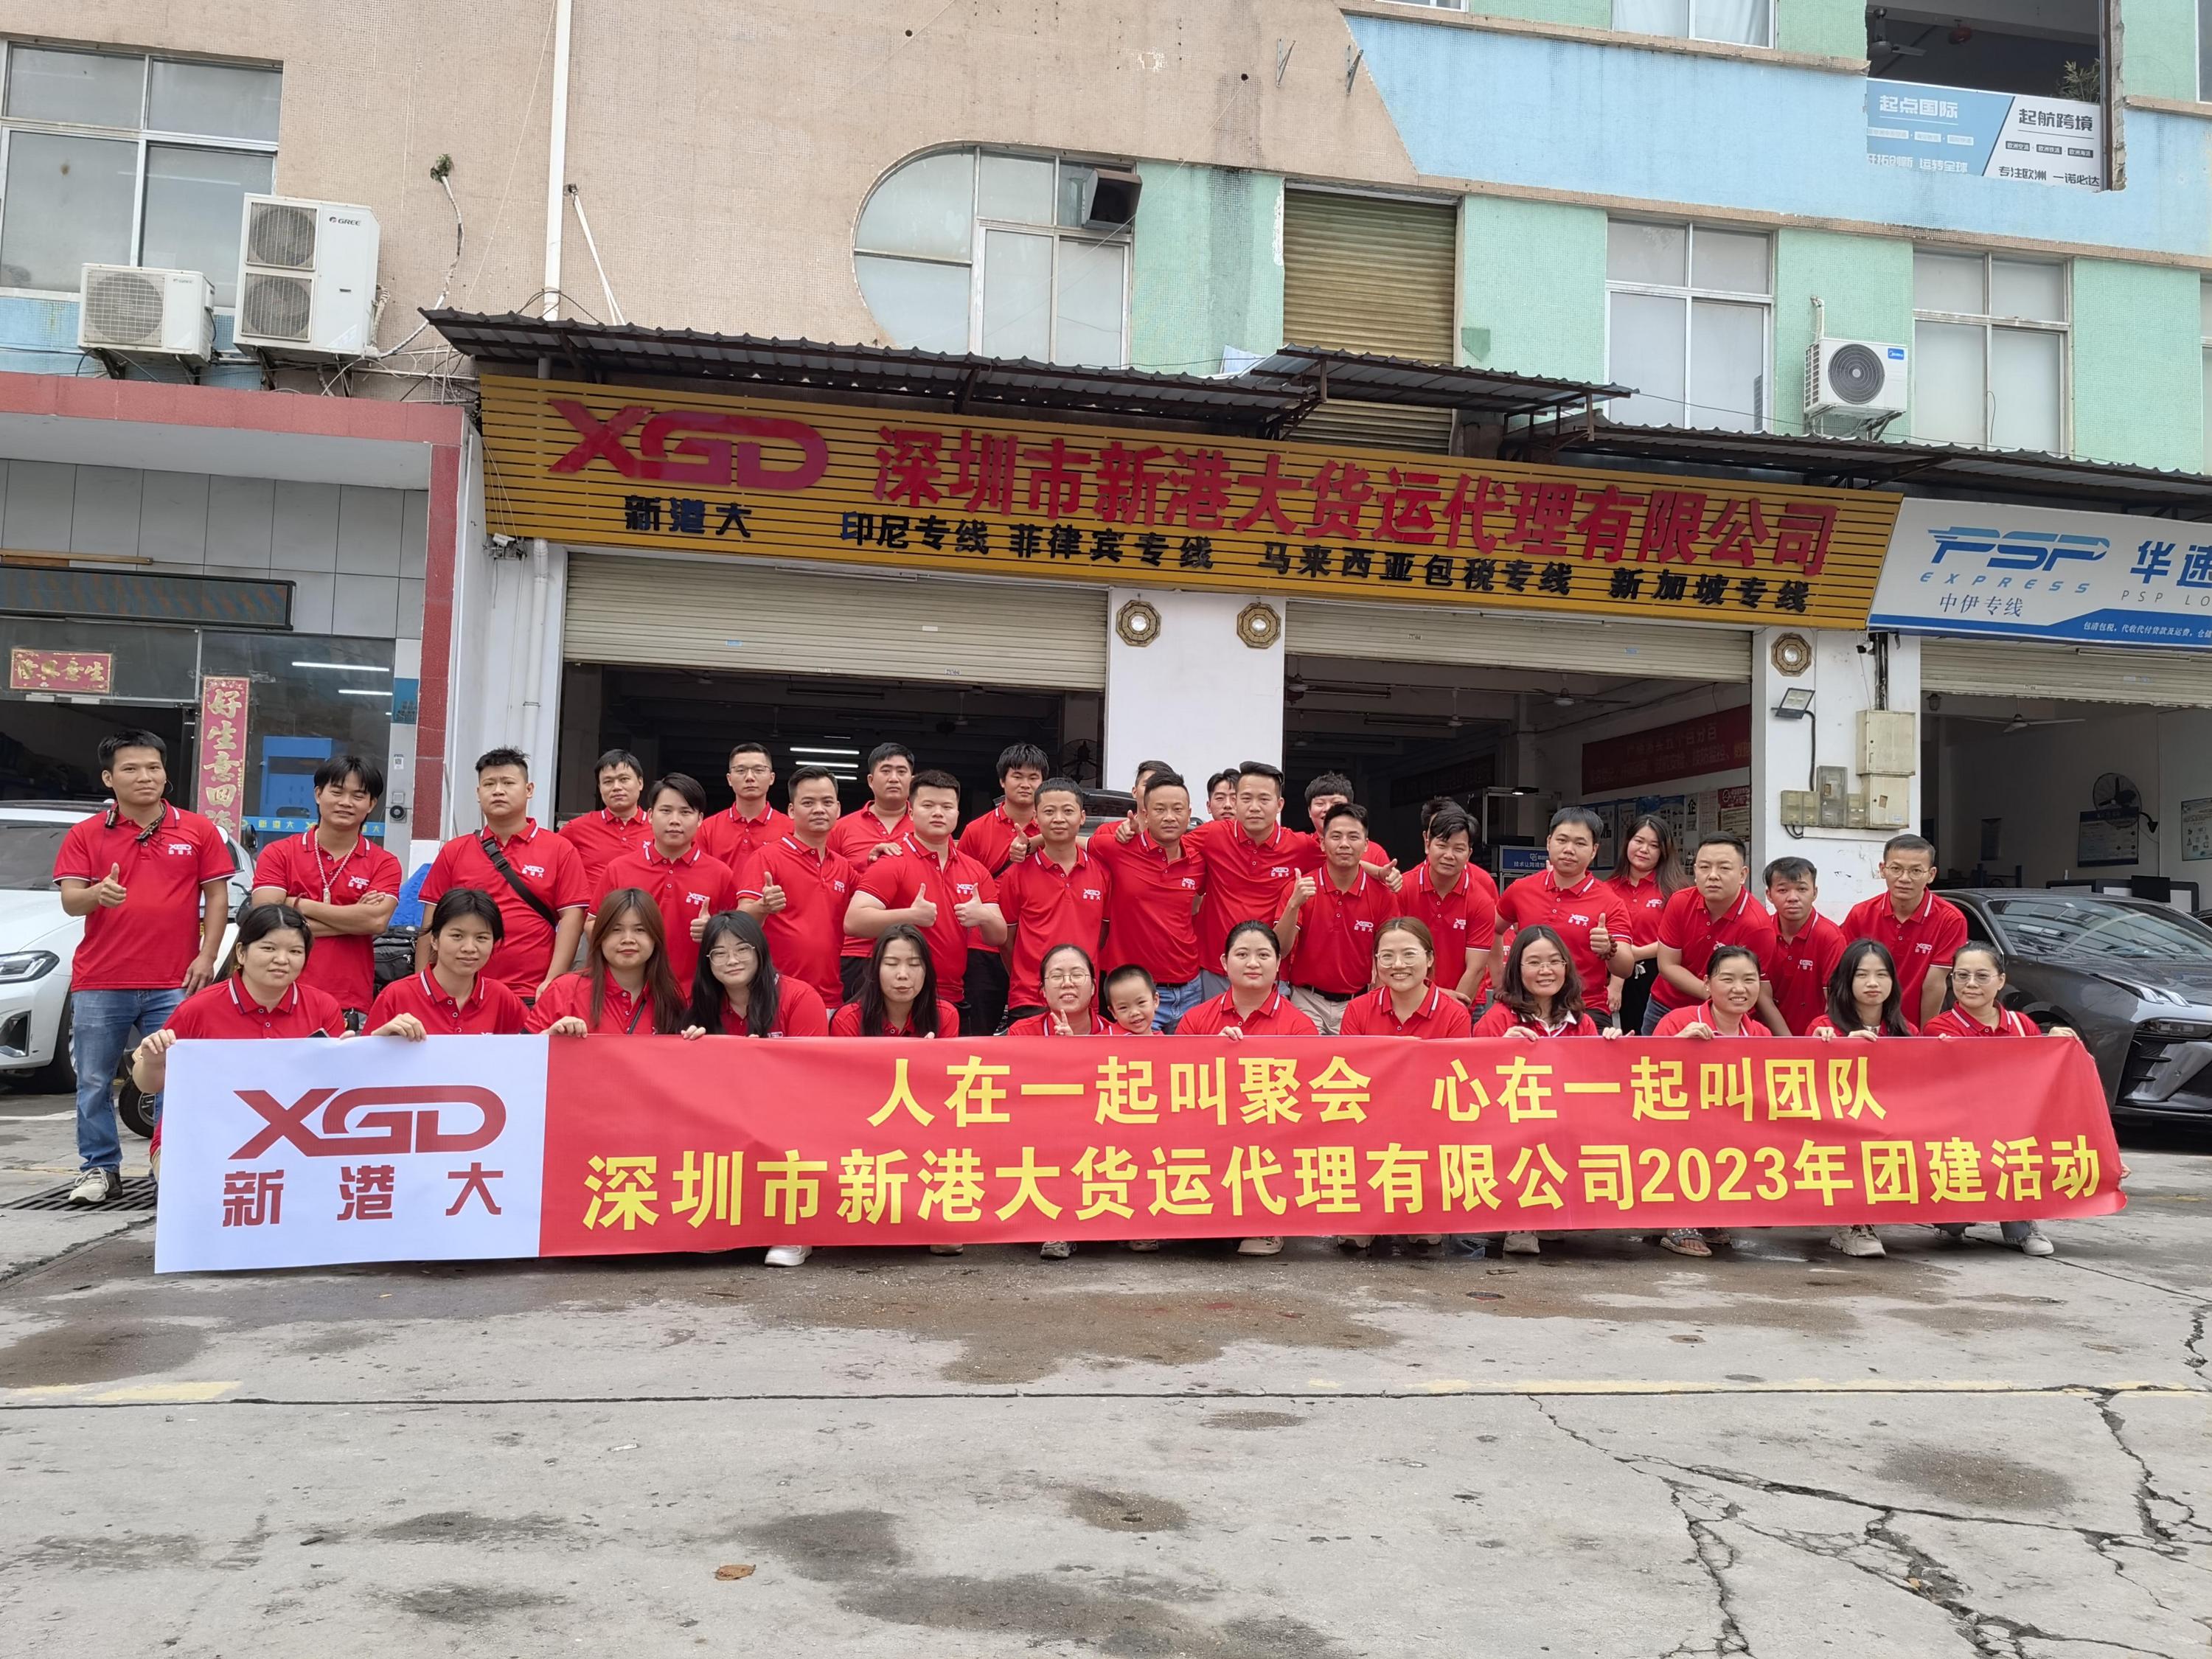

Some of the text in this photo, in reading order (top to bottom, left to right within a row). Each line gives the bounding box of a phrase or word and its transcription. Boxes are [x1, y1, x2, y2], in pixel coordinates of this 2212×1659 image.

[1879, 94, 1958, 119] 起点国际
[2019, 108, 2093, 131] 起航跨境
[1919, 157, 1968, 173] 运转全球
[1998, 166, 2100, 187] 专注欧洲 一诺必达
[338, 218, 361, 226] GREE
[548, 398, 829, 490] XGD
[625, 493, 752, 538] 新港大
[873, 425, 1841, 577] 深圳市新港大货运代理有限公司
[841, 510, 1809, 613] 印尼专线 菲律宾专线 马来西亚包税专线 新加坡专线
[1927, 526, 2110, 571] PSP
[1919, 571, 2090, 594] EXPRESS
[1938, 592, 2024, 618] 中伊专线
[2121, 590, 2163, 602] PSP
[866, 1055, 1888, 1127] 人在一起叫聚会 心在一起叫团队
[228, 1085, 507, 1161] XGD
[222, 1162, 504, 1228] 新港大
[582, 1134, 2101, 1231] 深圳市新港大货运代理有限公司2023年团建活动
